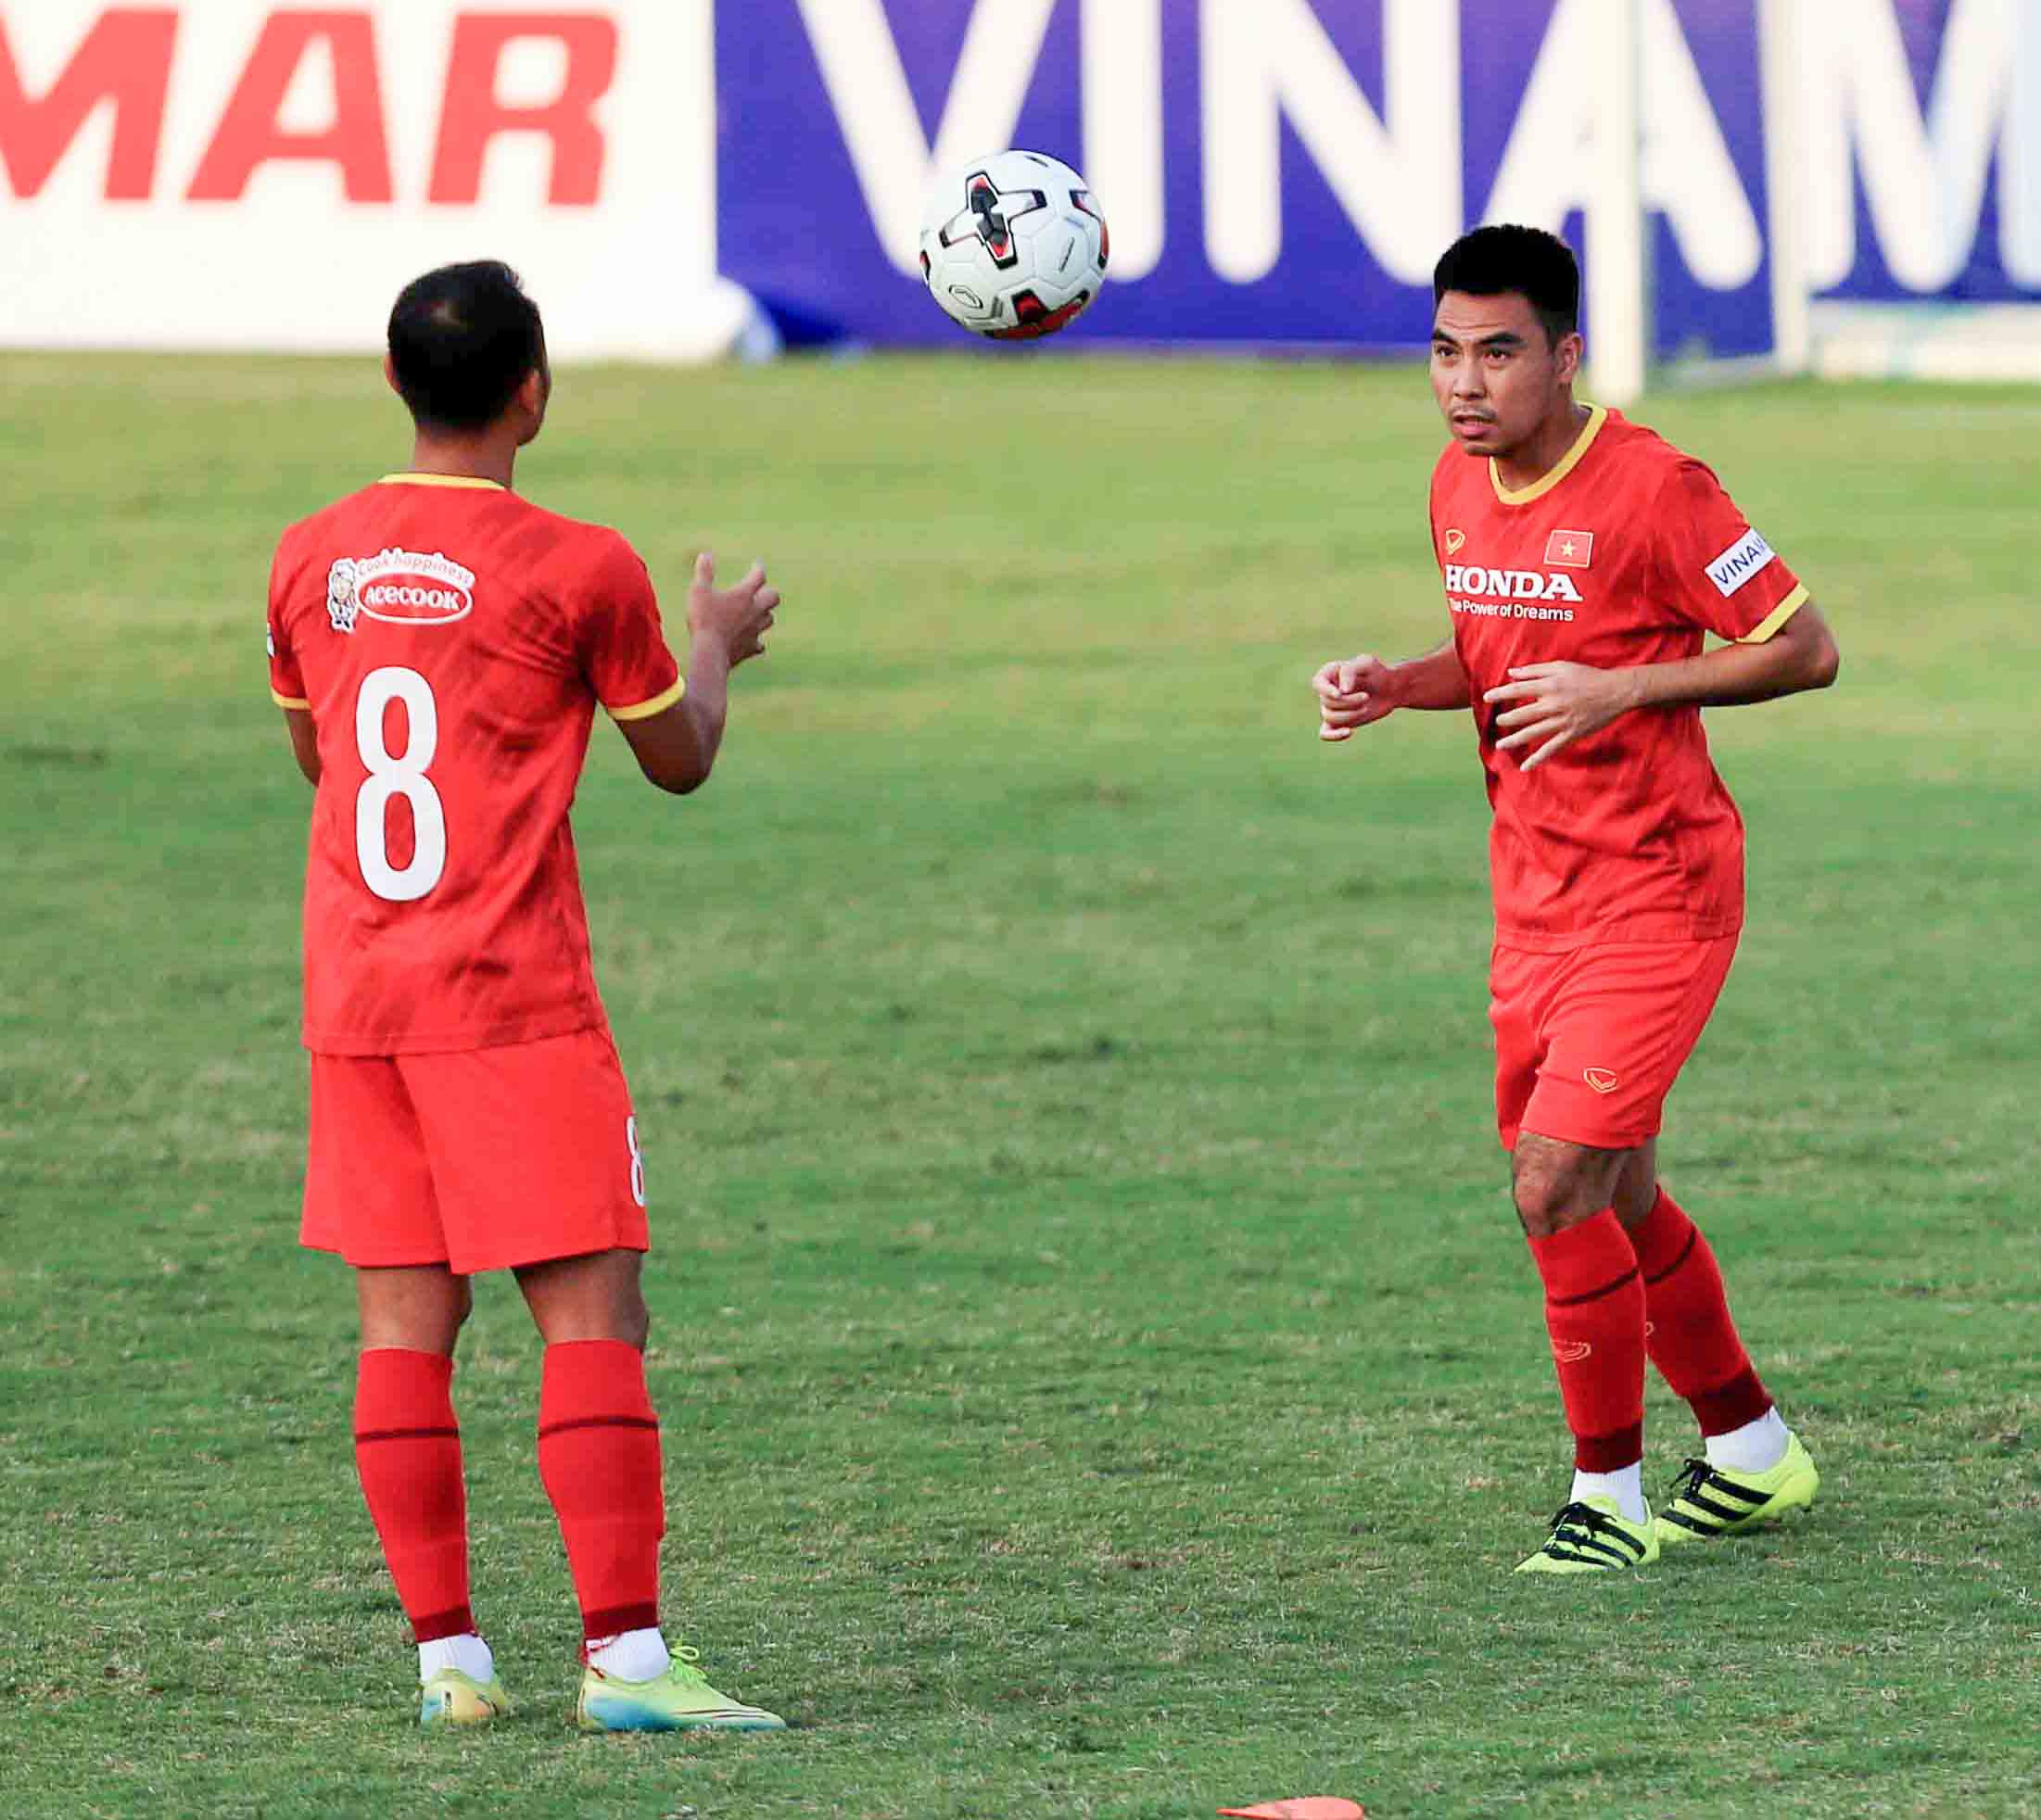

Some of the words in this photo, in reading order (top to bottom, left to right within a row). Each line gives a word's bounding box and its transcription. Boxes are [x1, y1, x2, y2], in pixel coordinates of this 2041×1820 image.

[0, 8, 619, 207] MAR
[1445, 563, 1584, 602] HONDA
[1463, 599, 1499, 616] Power
[1500, 603, 1513, 618] of
[1514, 603, 1574, 621] Dreams
[356, 666, 444, 901] 8
